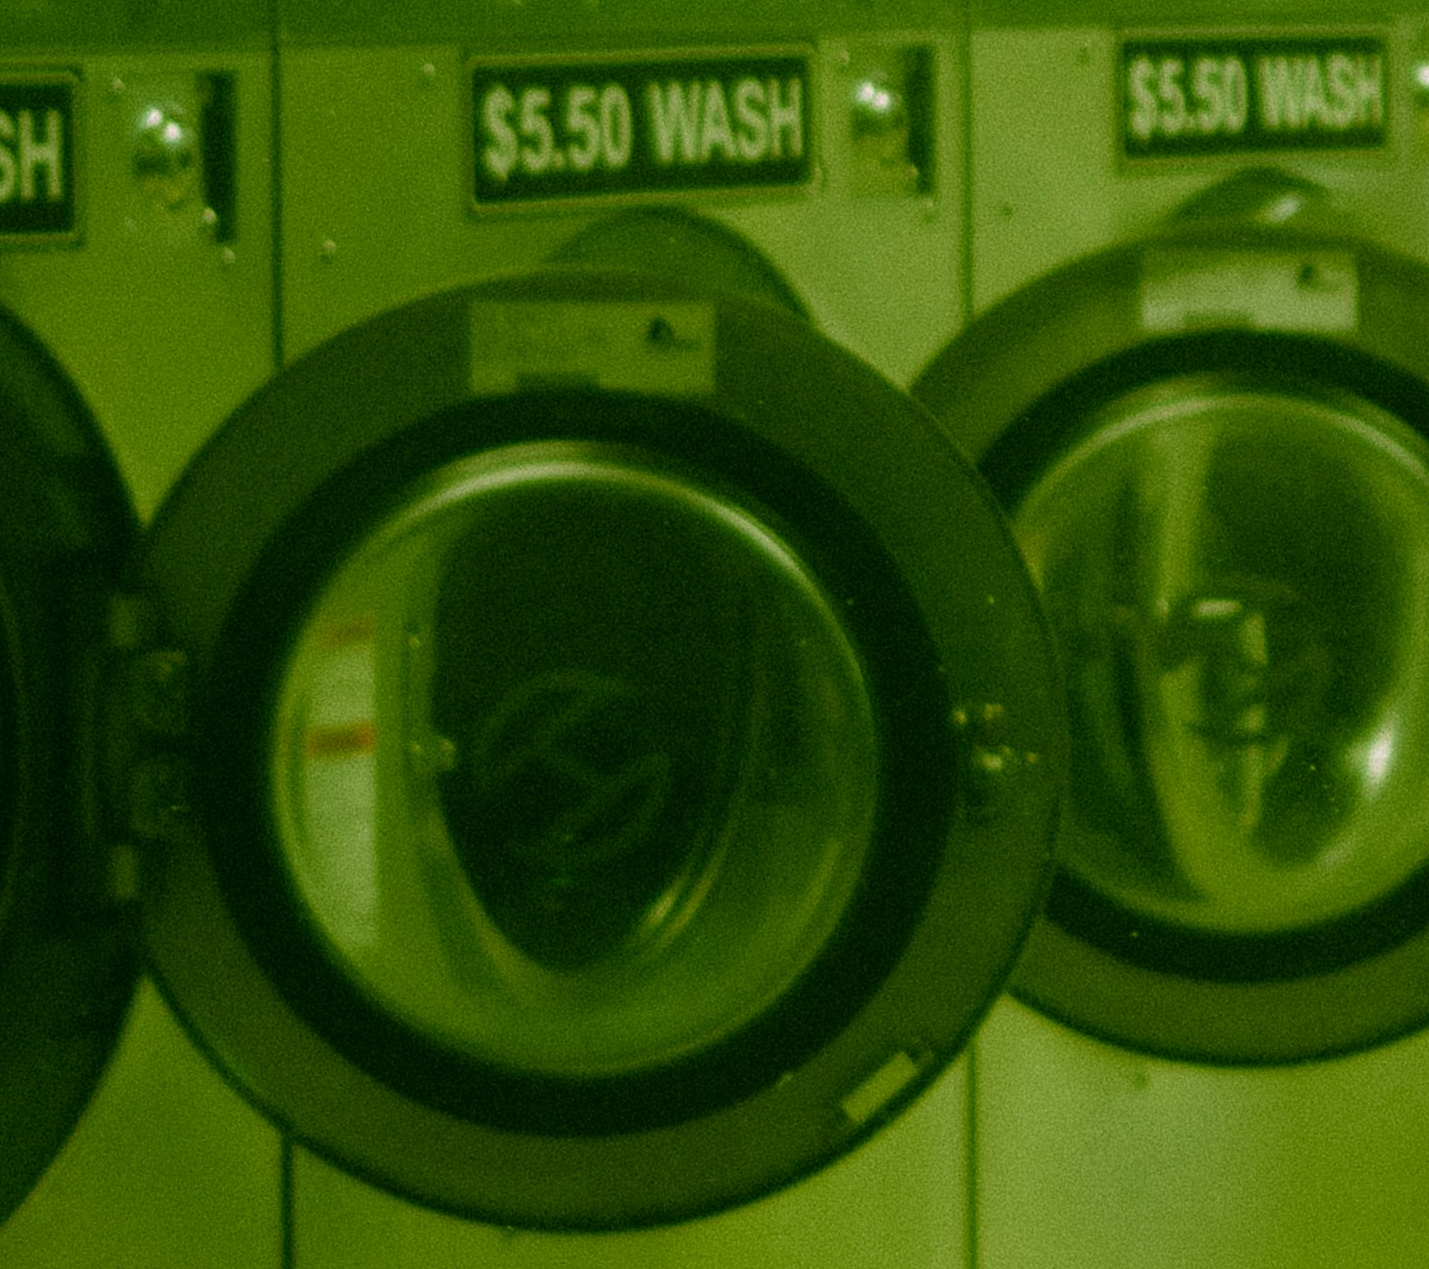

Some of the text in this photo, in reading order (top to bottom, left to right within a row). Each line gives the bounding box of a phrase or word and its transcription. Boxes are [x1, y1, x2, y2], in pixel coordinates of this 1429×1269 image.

[483, 78, 803, 180] $5.50 WASH
[1128, 53, 1383, 139] $5.50 WASH
